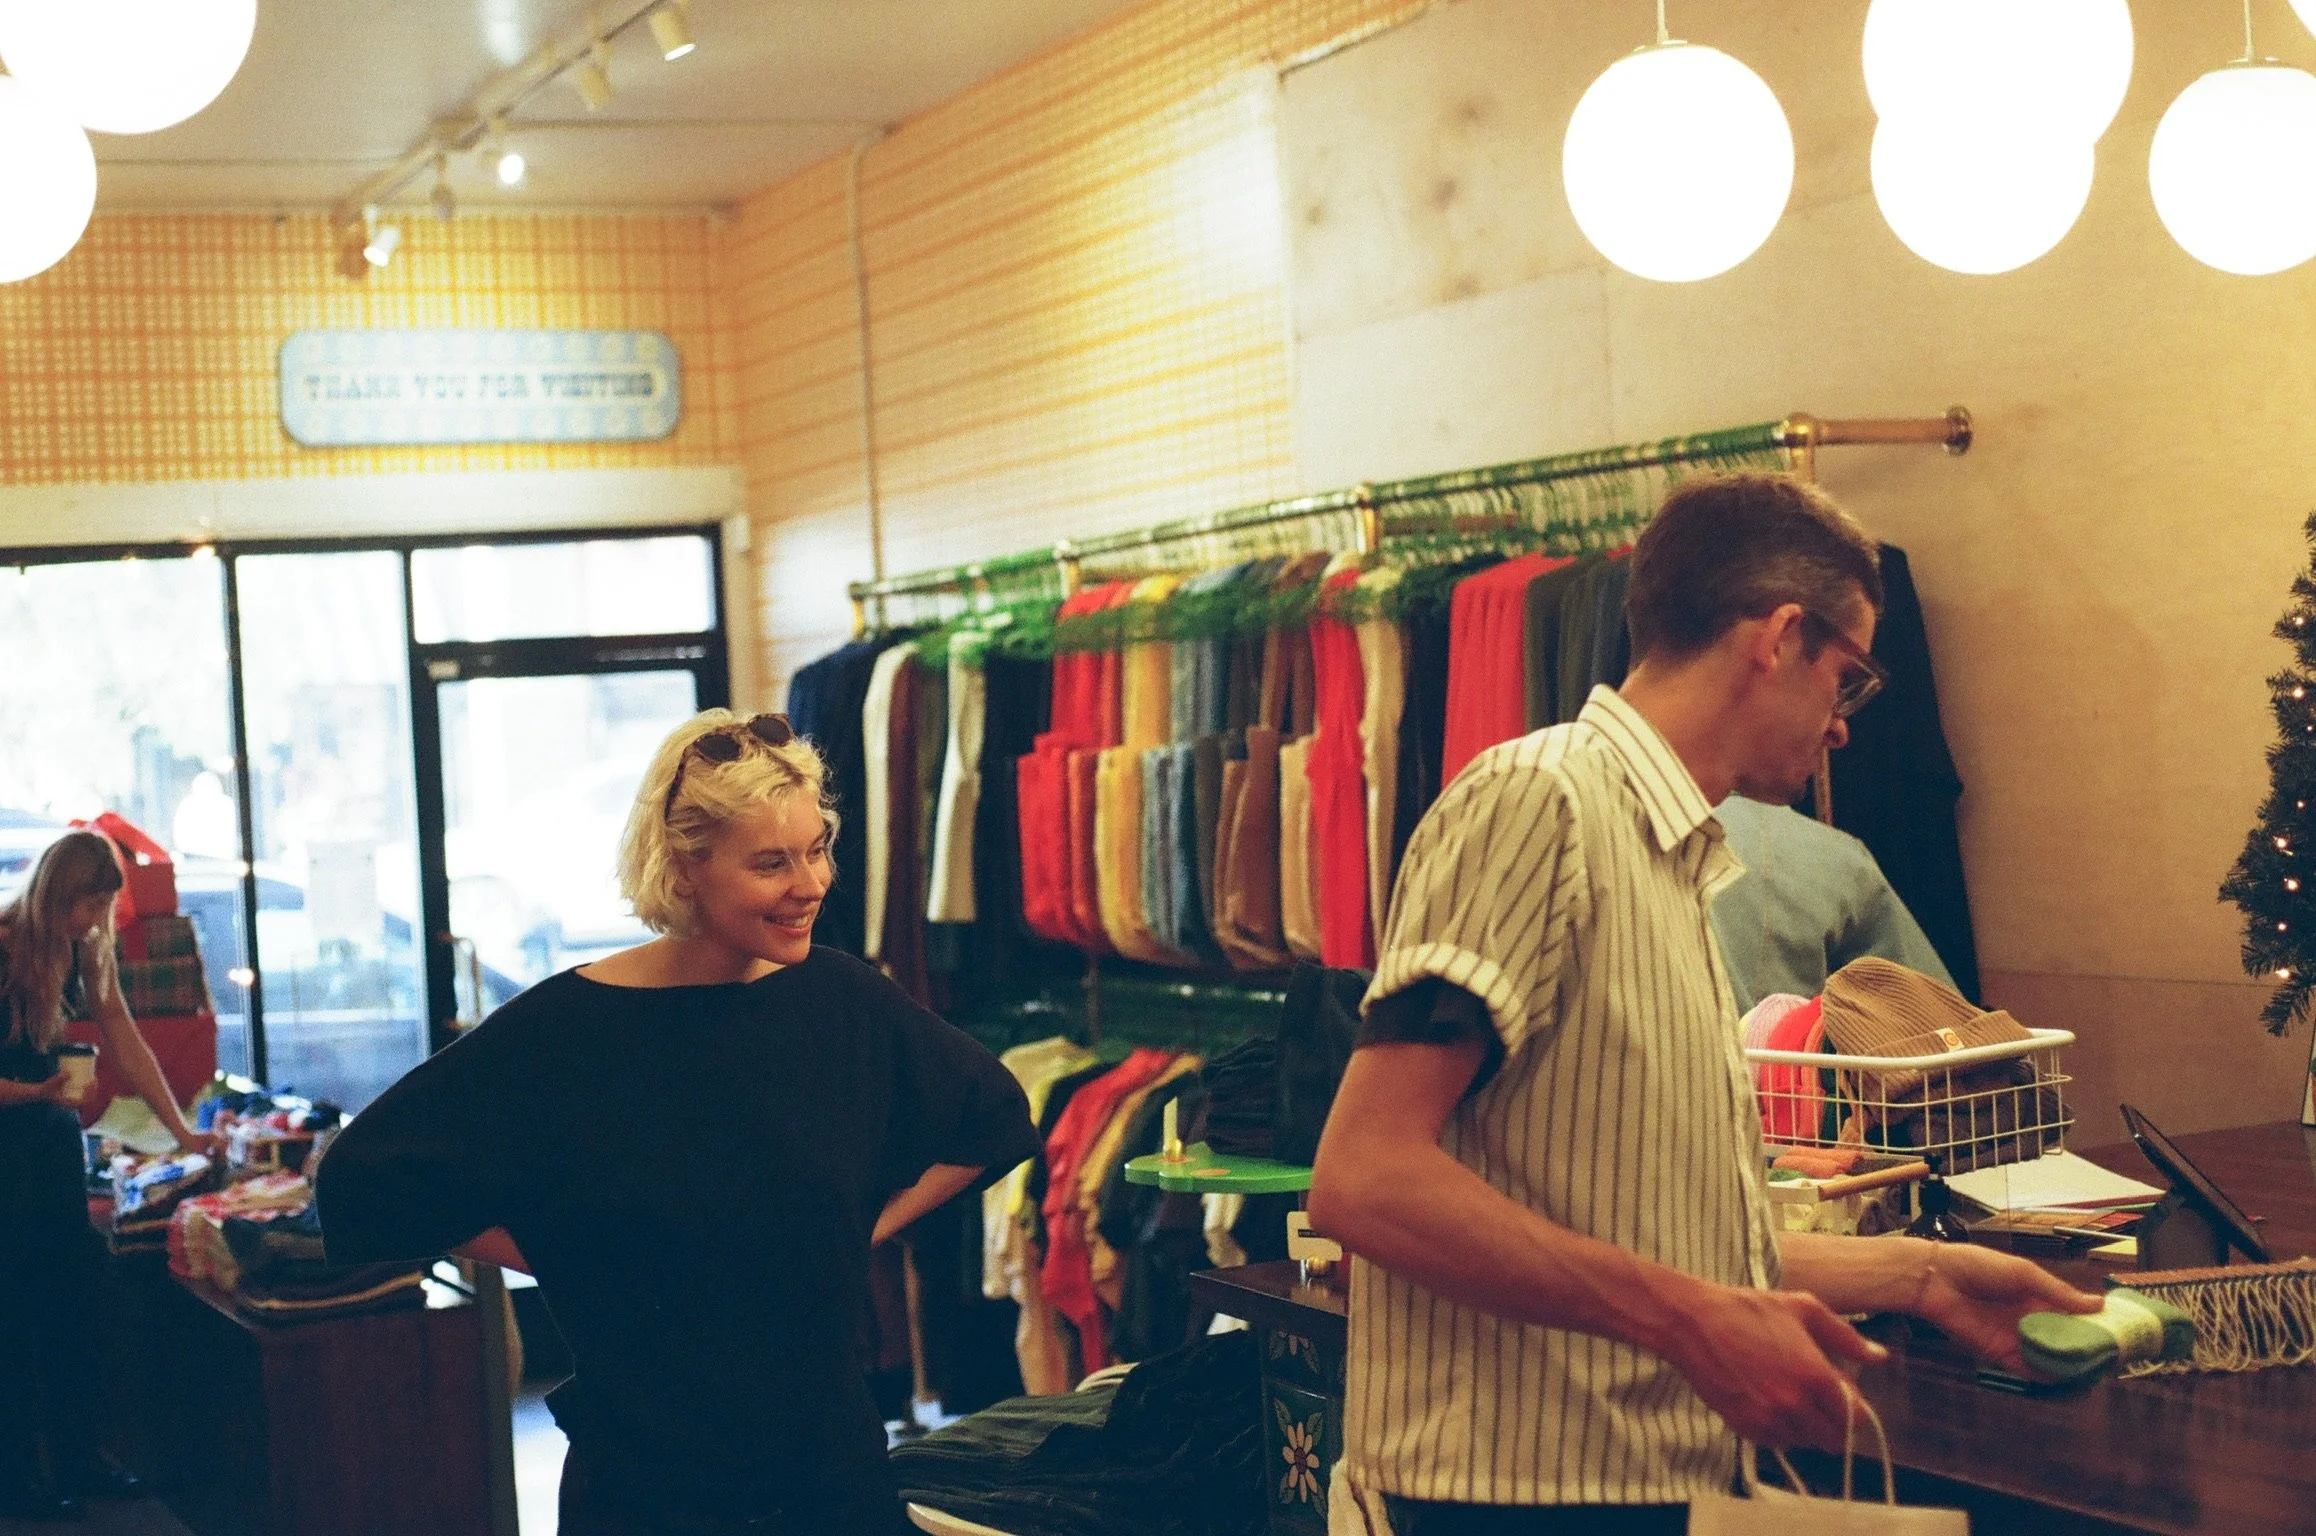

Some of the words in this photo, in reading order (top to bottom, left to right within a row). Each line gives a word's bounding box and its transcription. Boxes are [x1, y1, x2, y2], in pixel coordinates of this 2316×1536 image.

[305, 373, 402, 399] THANK
[414, 373, 468, 398] YOU
[480, 373, 529, 397] FOR
